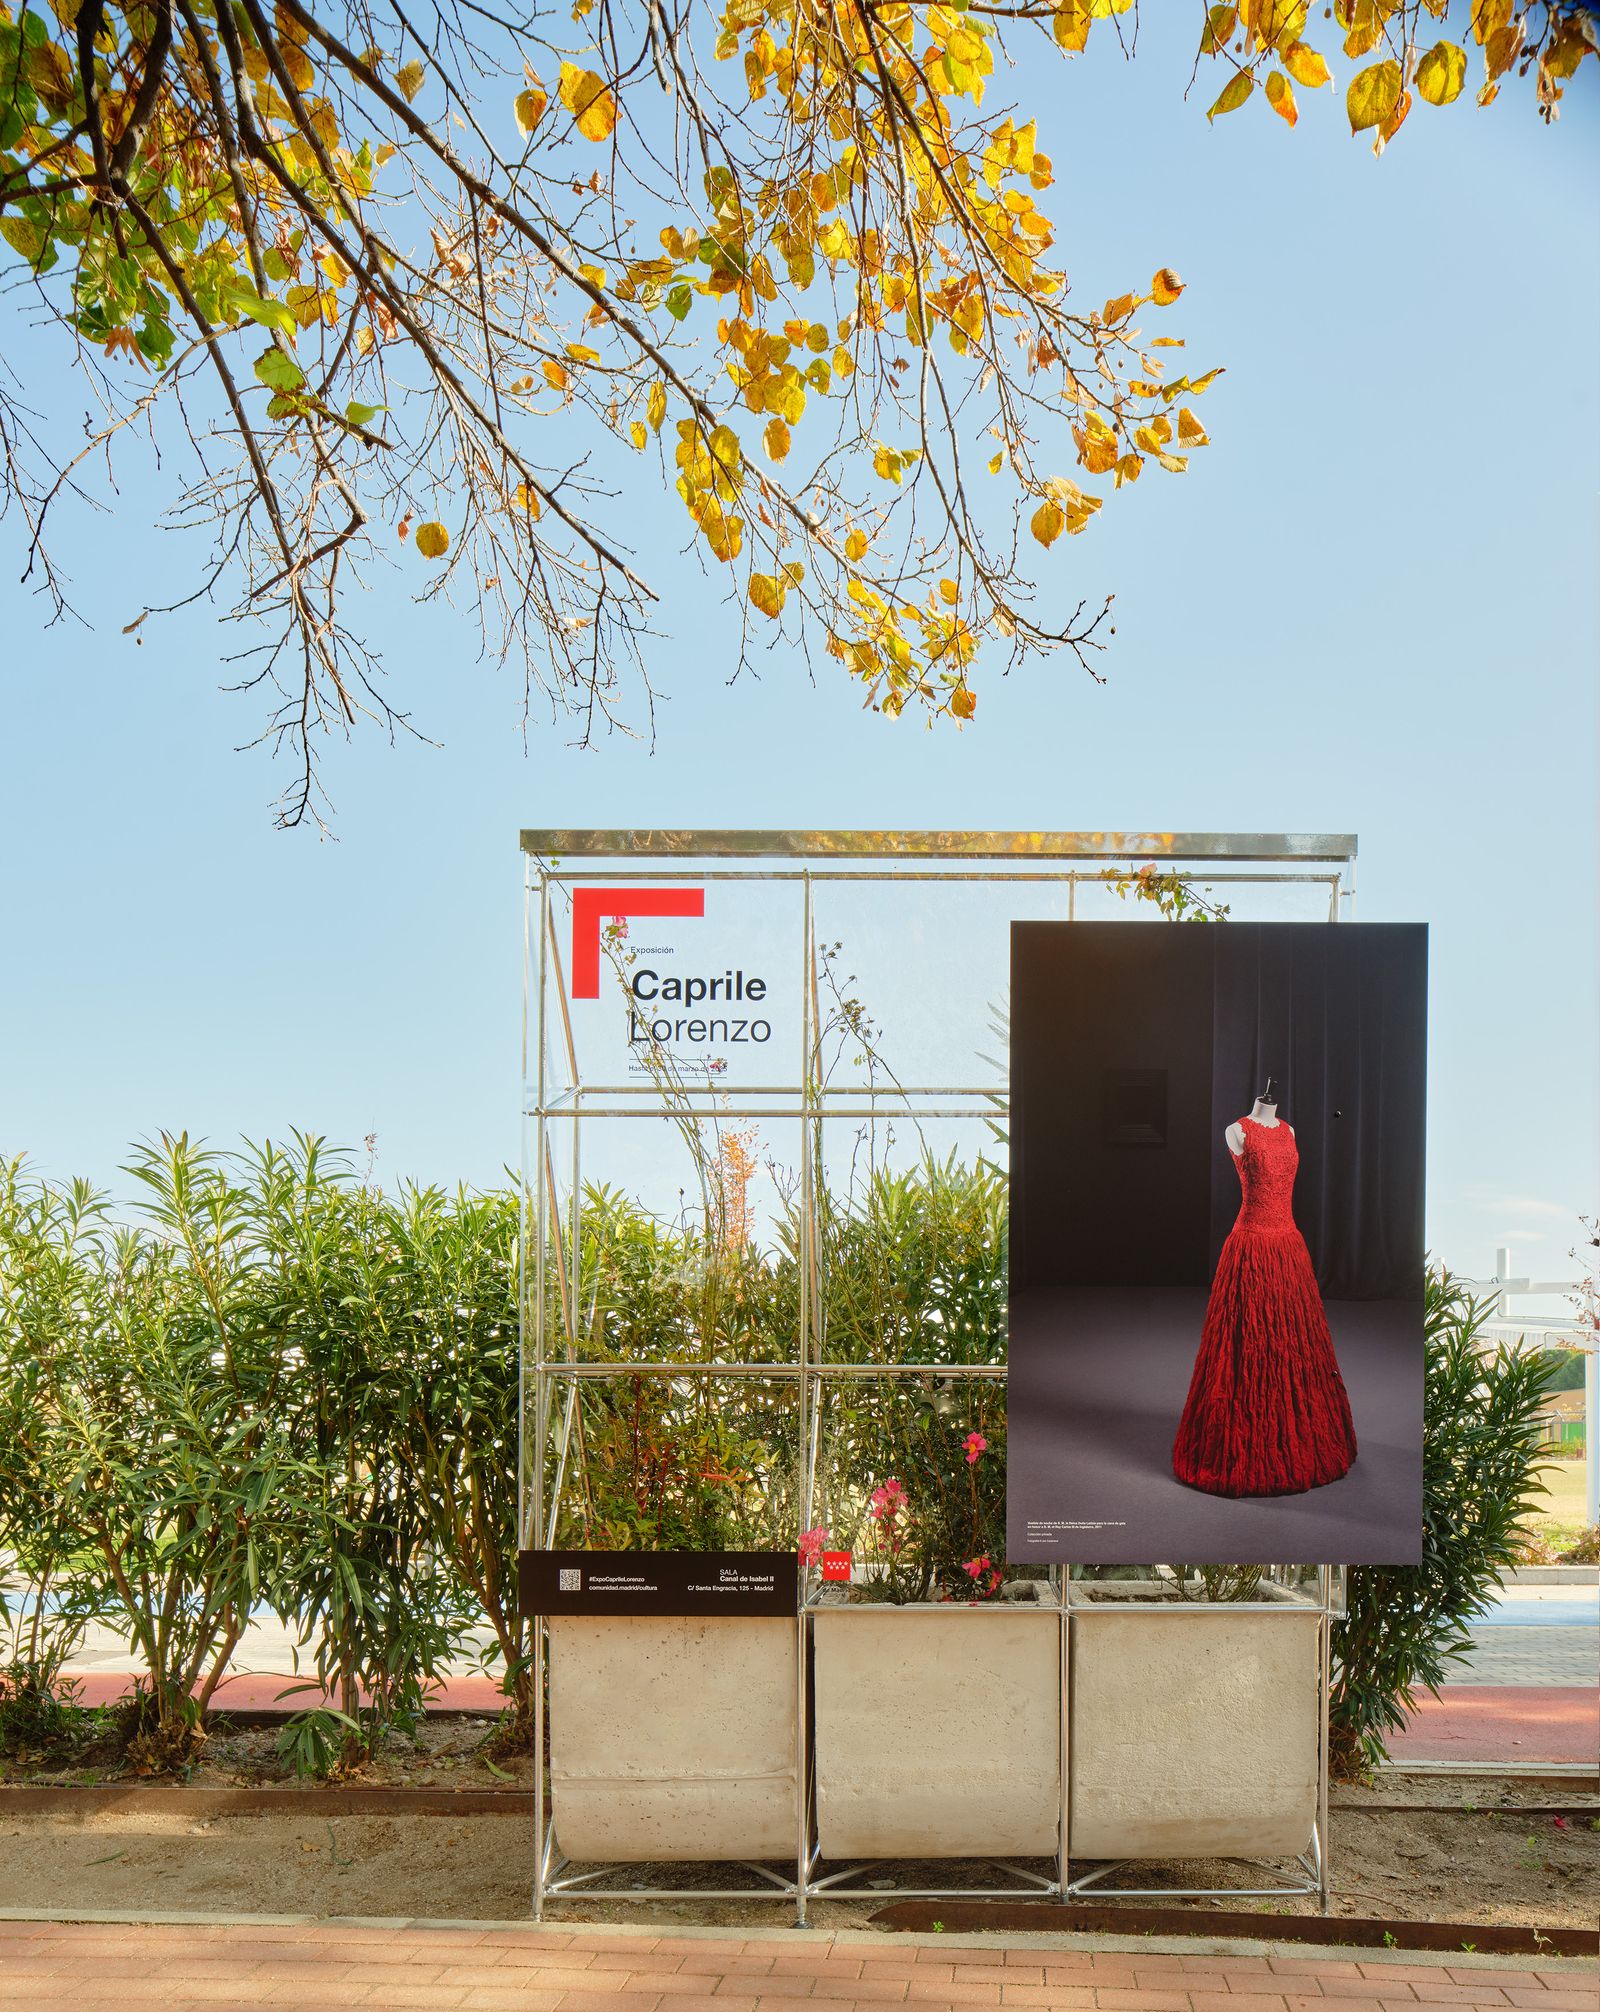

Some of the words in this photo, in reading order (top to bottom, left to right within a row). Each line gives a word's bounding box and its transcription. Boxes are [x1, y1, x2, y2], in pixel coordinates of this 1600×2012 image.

[630, 946, 674, 955] Exposición
[632, 969, 767, 1008] Caprile
[631, 1011, 772, 1042] Lorenzo
